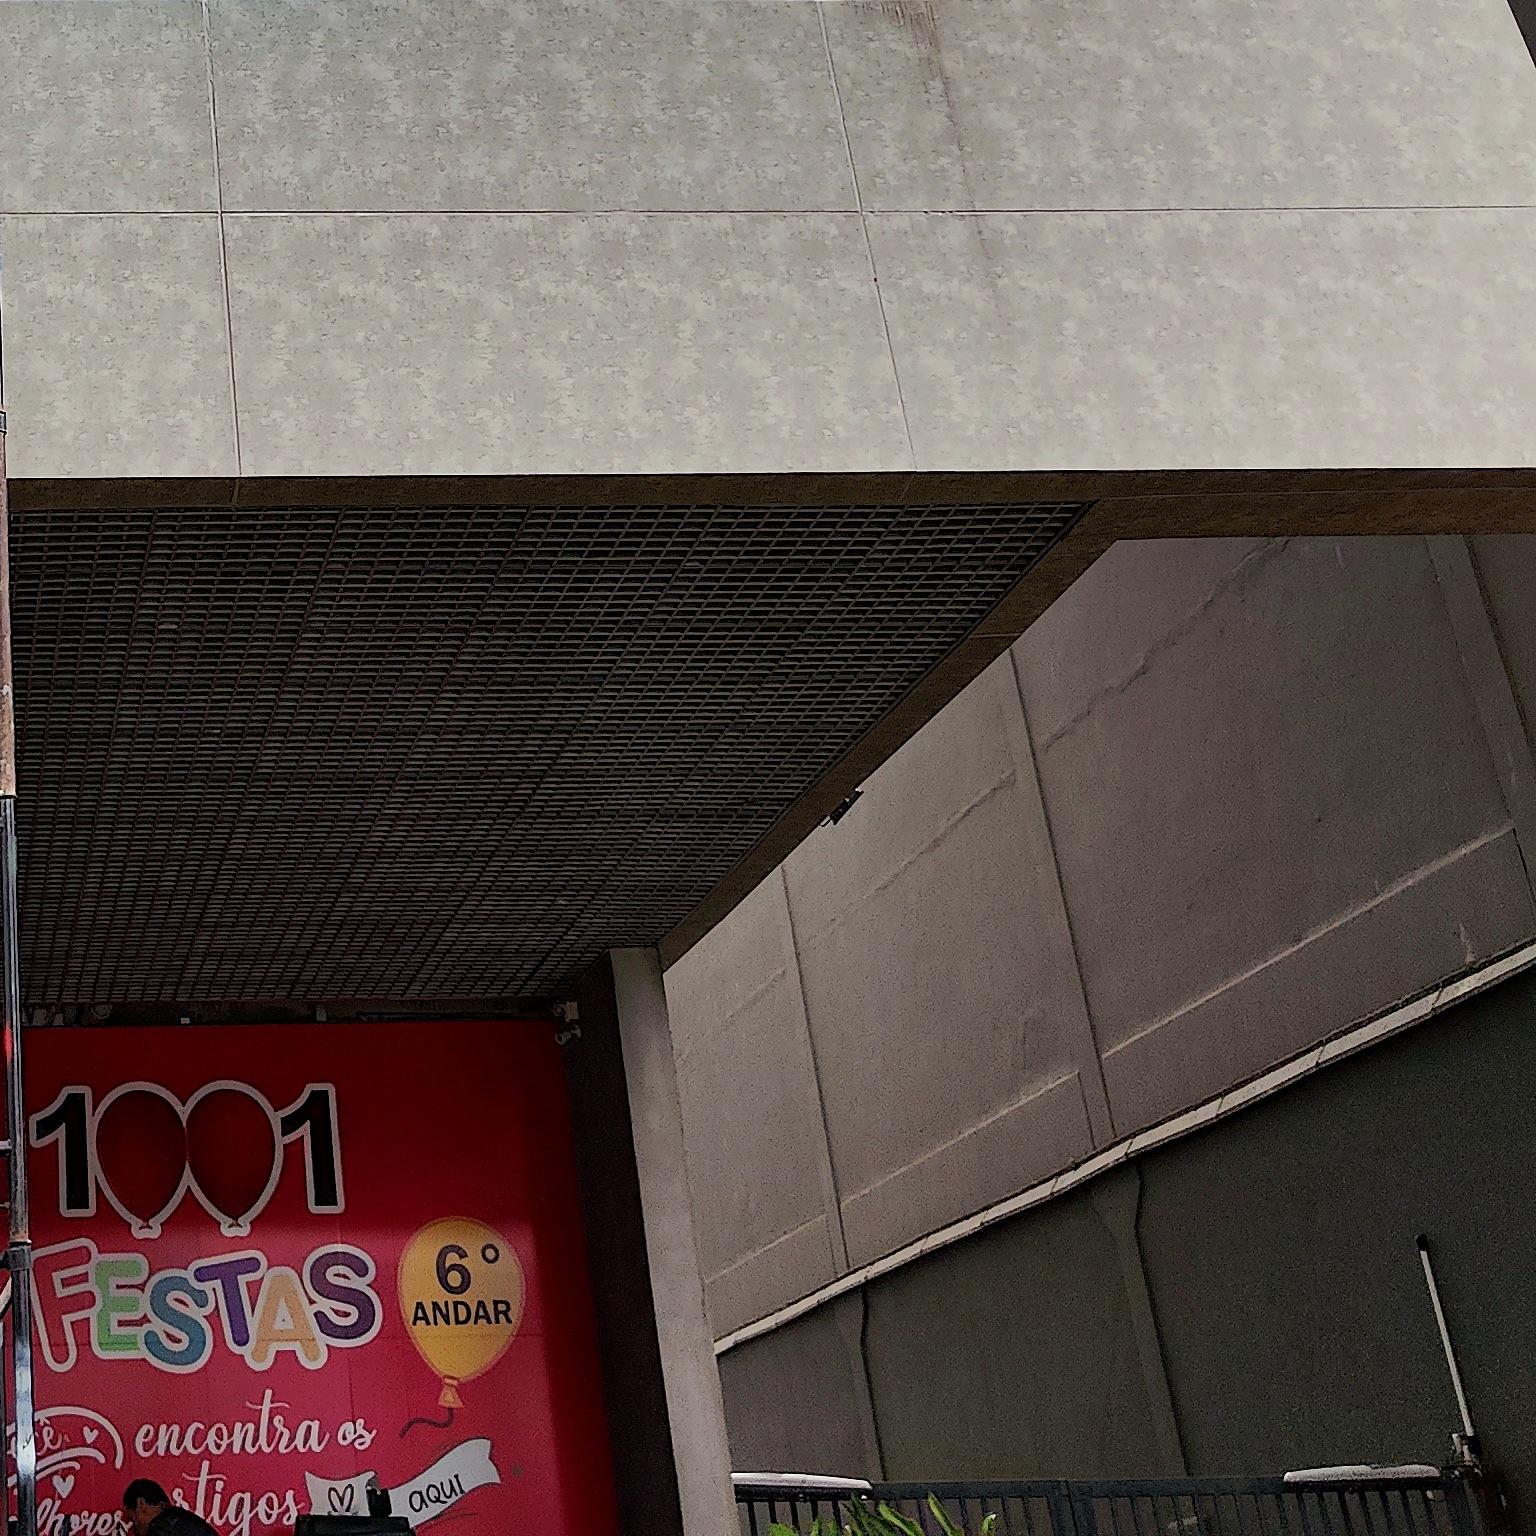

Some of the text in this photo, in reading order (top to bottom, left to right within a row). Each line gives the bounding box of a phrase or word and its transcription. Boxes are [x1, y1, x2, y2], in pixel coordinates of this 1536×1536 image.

[29, 1237, 384, 1372] FESTAS
[412, 1299, 513, 1327] ANDAR
[134, 1388, 378, 1457] encontra os
[170, 1459, 306, 1536] rtigos
